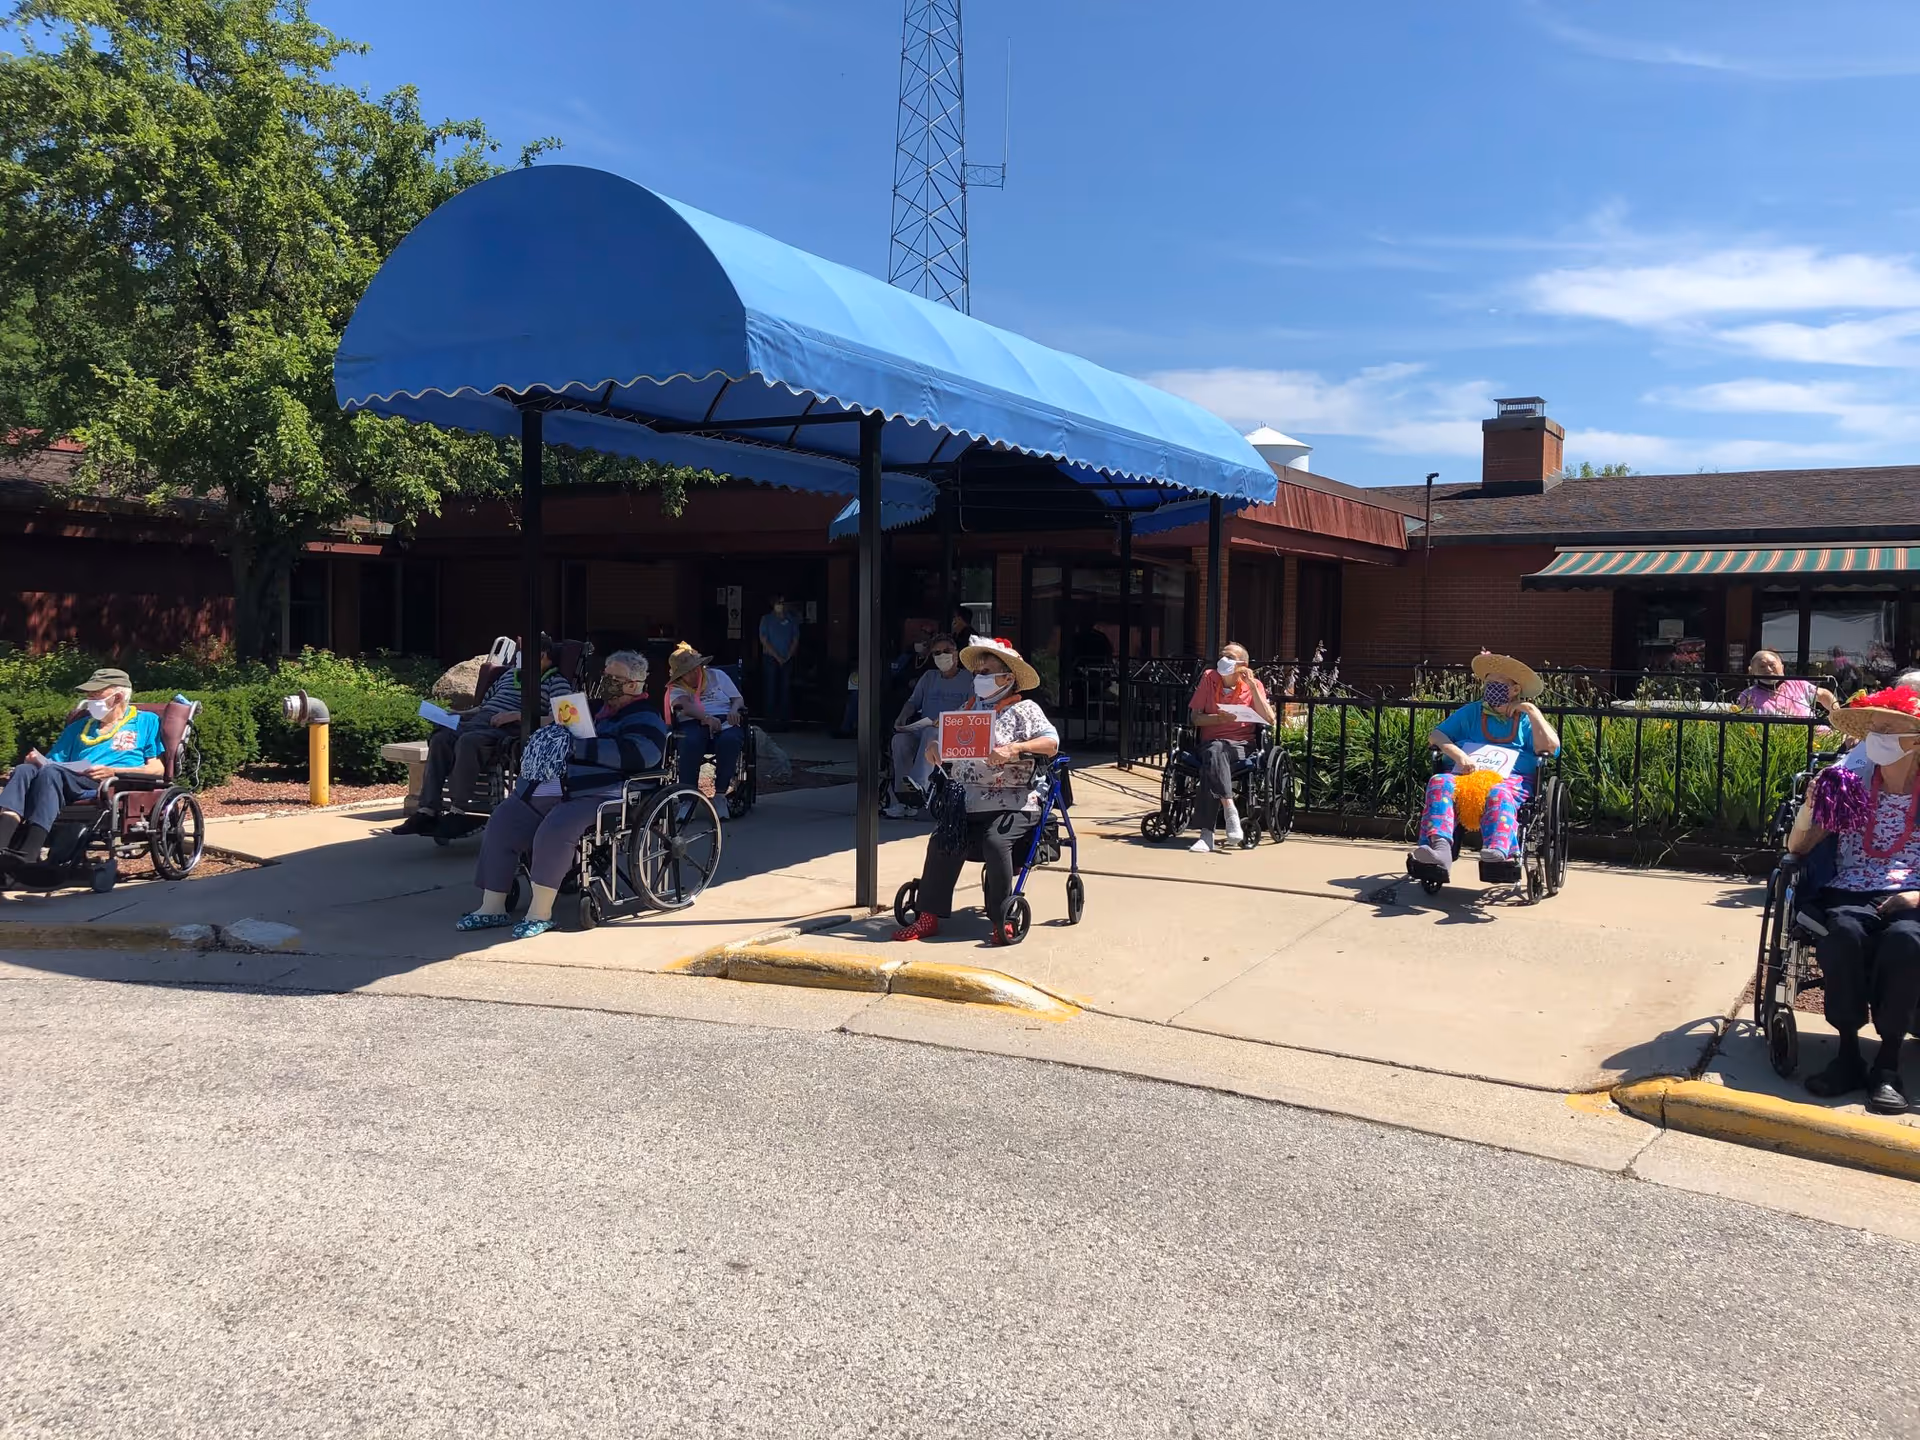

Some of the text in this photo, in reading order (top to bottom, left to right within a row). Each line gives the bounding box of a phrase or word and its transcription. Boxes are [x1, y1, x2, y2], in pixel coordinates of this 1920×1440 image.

[944, 715, 990, 726] See You
[946, 747, 976, 757] SOON
[1476, 757, 1502, 766] LOVE
